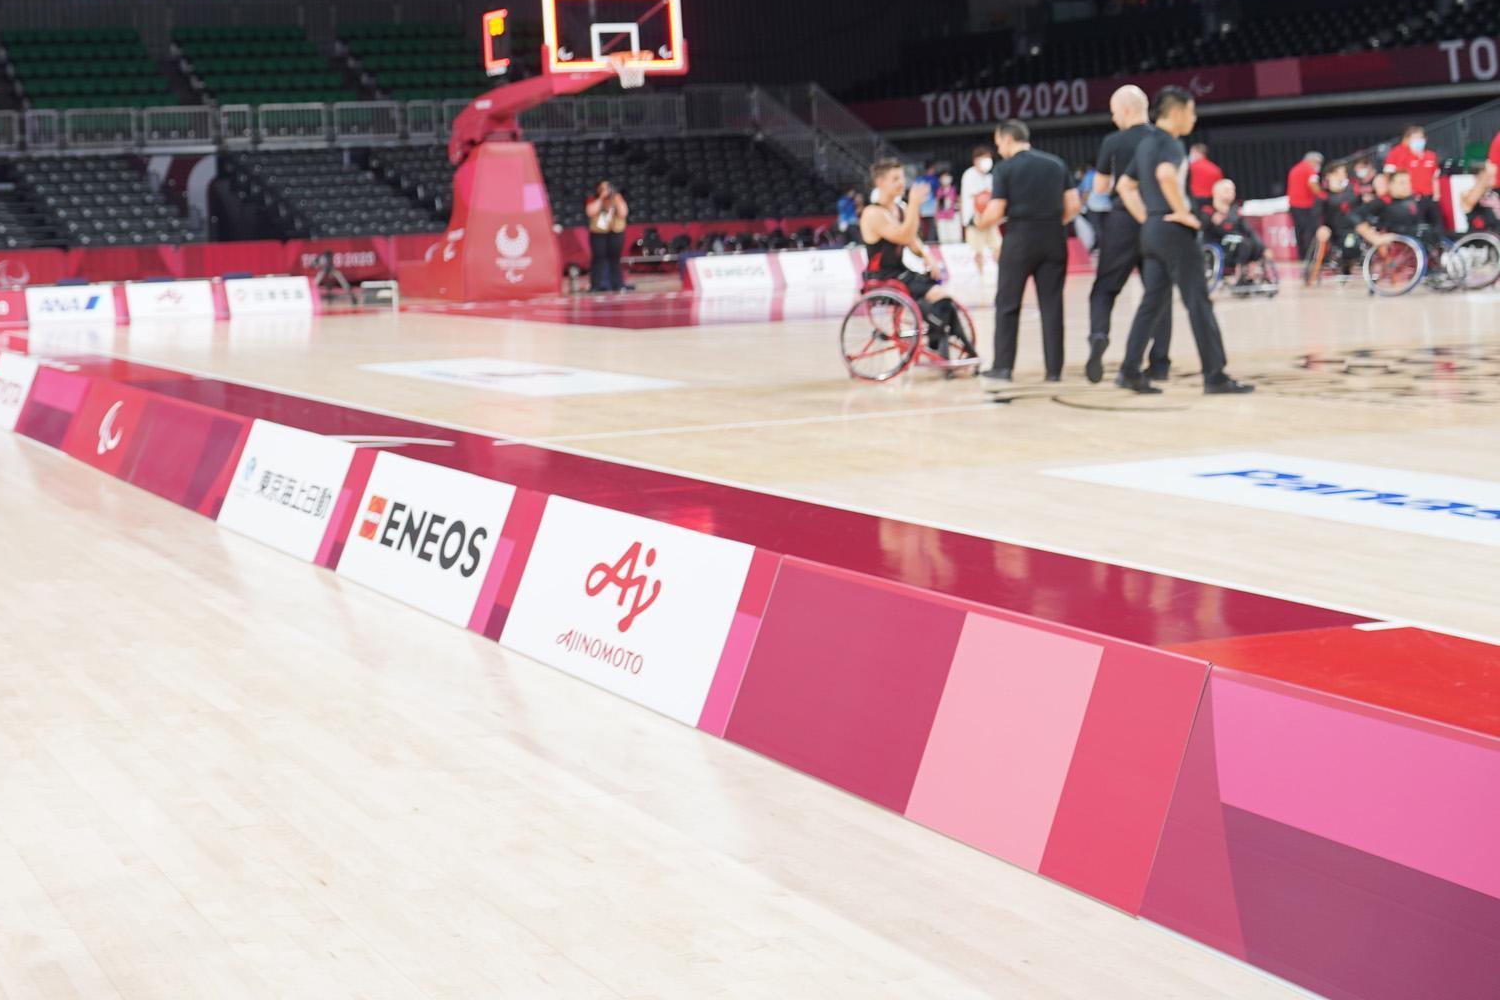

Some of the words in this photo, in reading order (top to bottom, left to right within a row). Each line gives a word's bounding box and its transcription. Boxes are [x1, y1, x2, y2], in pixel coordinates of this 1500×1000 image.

[922, 86, 1011, 127] TOKYO
[1017, 78, 1088, 119] 2020
[380, 502, 487, 578] ENEOS
[556, 629, 644, 675] AJINOMOTO
